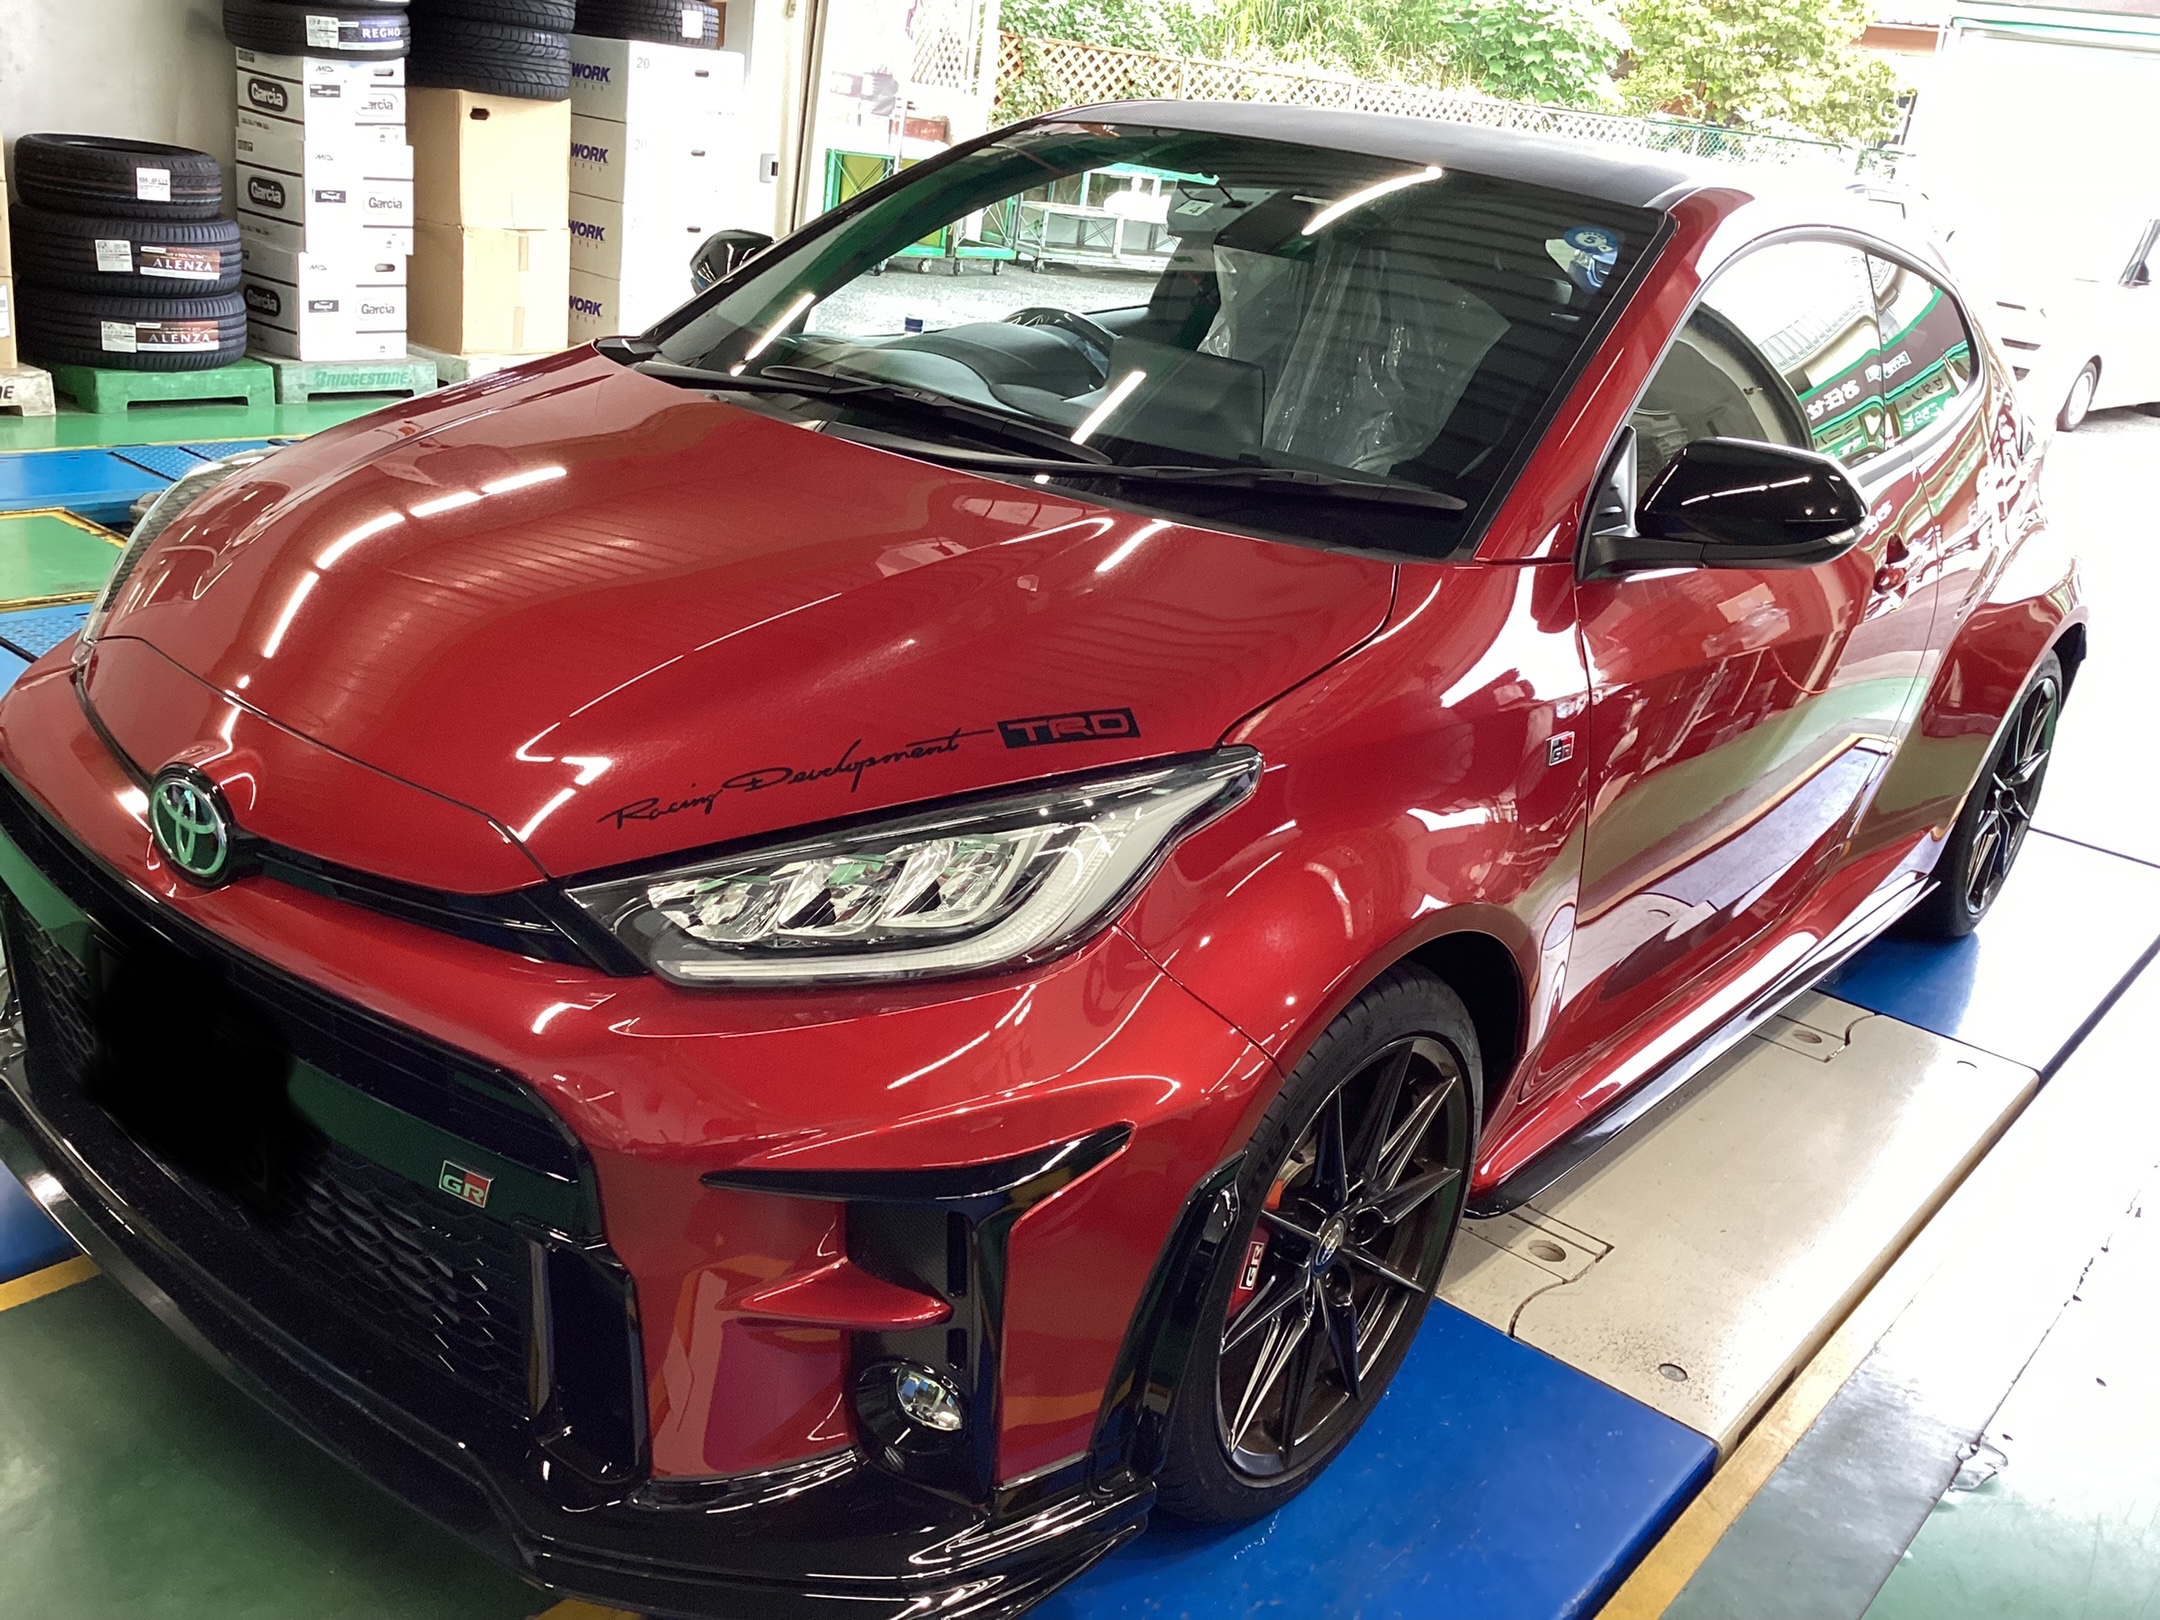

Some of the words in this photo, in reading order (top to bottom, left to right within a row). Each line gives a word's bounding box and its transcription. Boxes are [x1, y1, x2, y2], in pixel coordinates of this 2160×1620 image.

[361, 27, 401, 39] REGNO
[568, 61, 611, 82] WORK
[636, 56, 650, 69] 20
[250, 82, 284, 107] Garcia
[361, 98, 394, 111] arcia
[570, 142, 609, 163] WORK
[250, 181, 282, 204] Garcia
[368, 196, 403, 209] Garcia
[568, 219, 606, 241] WORK
[1583, 236, 1598, 244] 5
[152, 257, 213, 272] ALENZA
[246, 288, 278, 312] Garcia
[361, 302, 395, 315] Garcia
[148, 333, 211, 343] ALENZA
[314, 371, 409, 388] BRIDGESTONE
[597, 782, 722, 830] Racing
[720, 727, 996, 793] Development
[1004, 713, 1132, 743] TRD
[442, 1173, 485, 1204] GR
[1245, 1244, 1264, 1288] GR
